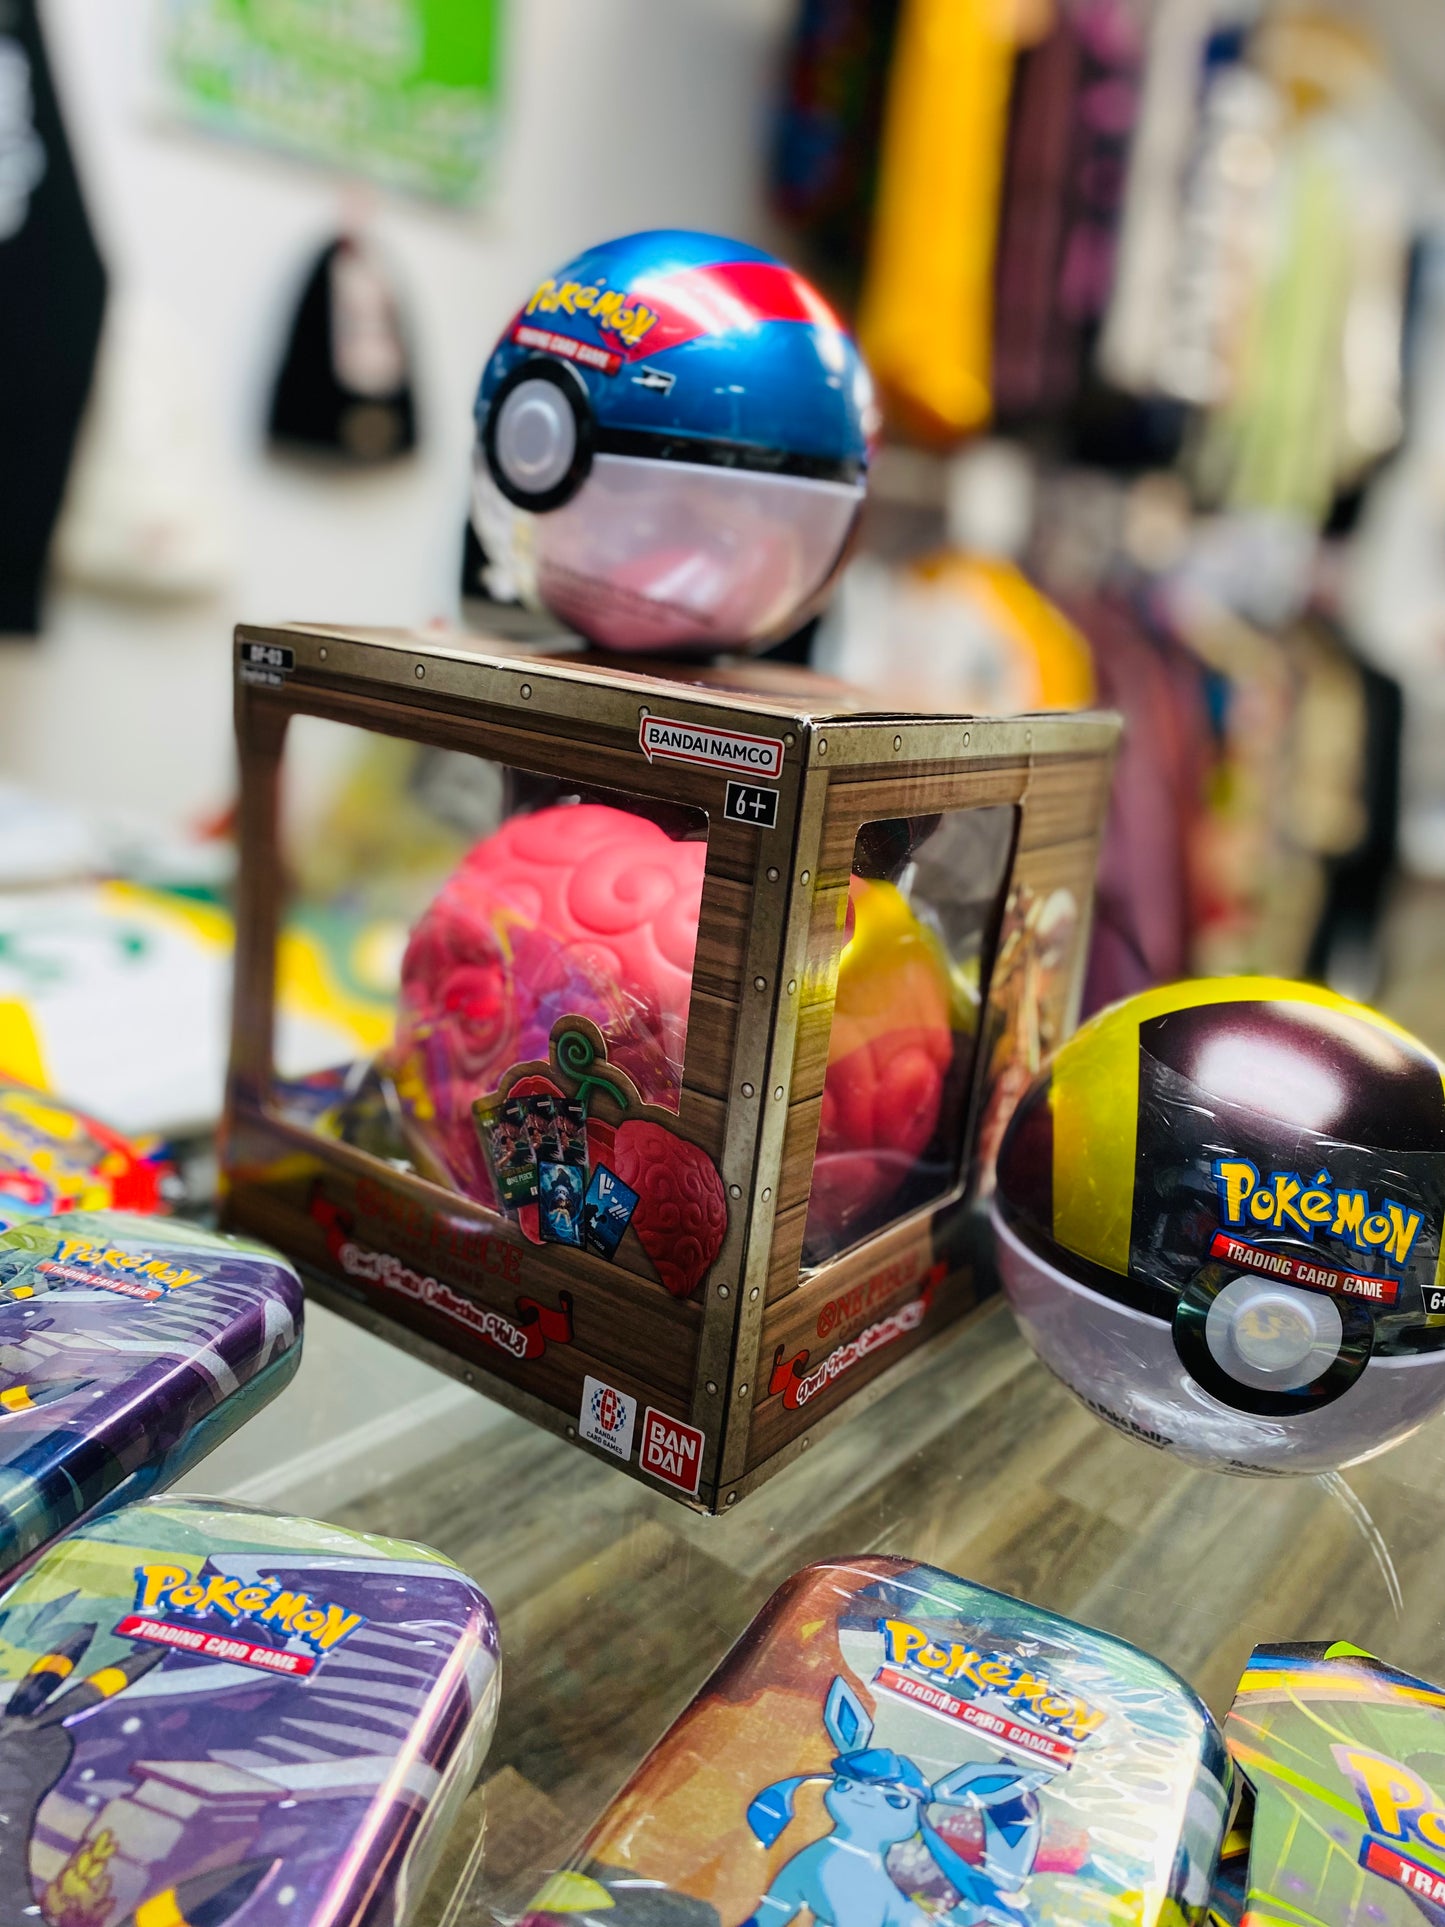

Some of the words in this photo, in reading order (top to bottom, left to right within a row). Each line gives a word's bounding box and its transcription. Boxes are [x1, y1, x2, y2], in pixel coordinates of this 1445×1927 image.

[649, 728, 708, 753] BANDAI
[711, 741, 773, 765] NAMCO
[735, 789, 767, 819] 6+
[91, 1274, 120, 1289] CARD
[118, 1283, 151, 1298] GAME
[1226, 1242, 1292, 1275] TRADING
[1296, 1266, 1338, 1289] CARD
[1342, 1278, 1384, 1299] GAME
[586, 1431, 603, 1443] CARD
[602, 1439, 624, 1455] GAMES
[594, 1427, 617, 1443] BANDAI
[650, 1420, 697, 1461] BAN
[647, 1441, 683, 1477] DAI
[137, 1620, 205, 1649] TRADING
[204, 1636, 250, 1659] CARD
[249, 1649, 299, 1671] GAME
[894, 1676, 960, 1714] TRADING
[961, 1705, 1004, 1734] CARD
[1008, 1728, 1056, 1753] GAME
